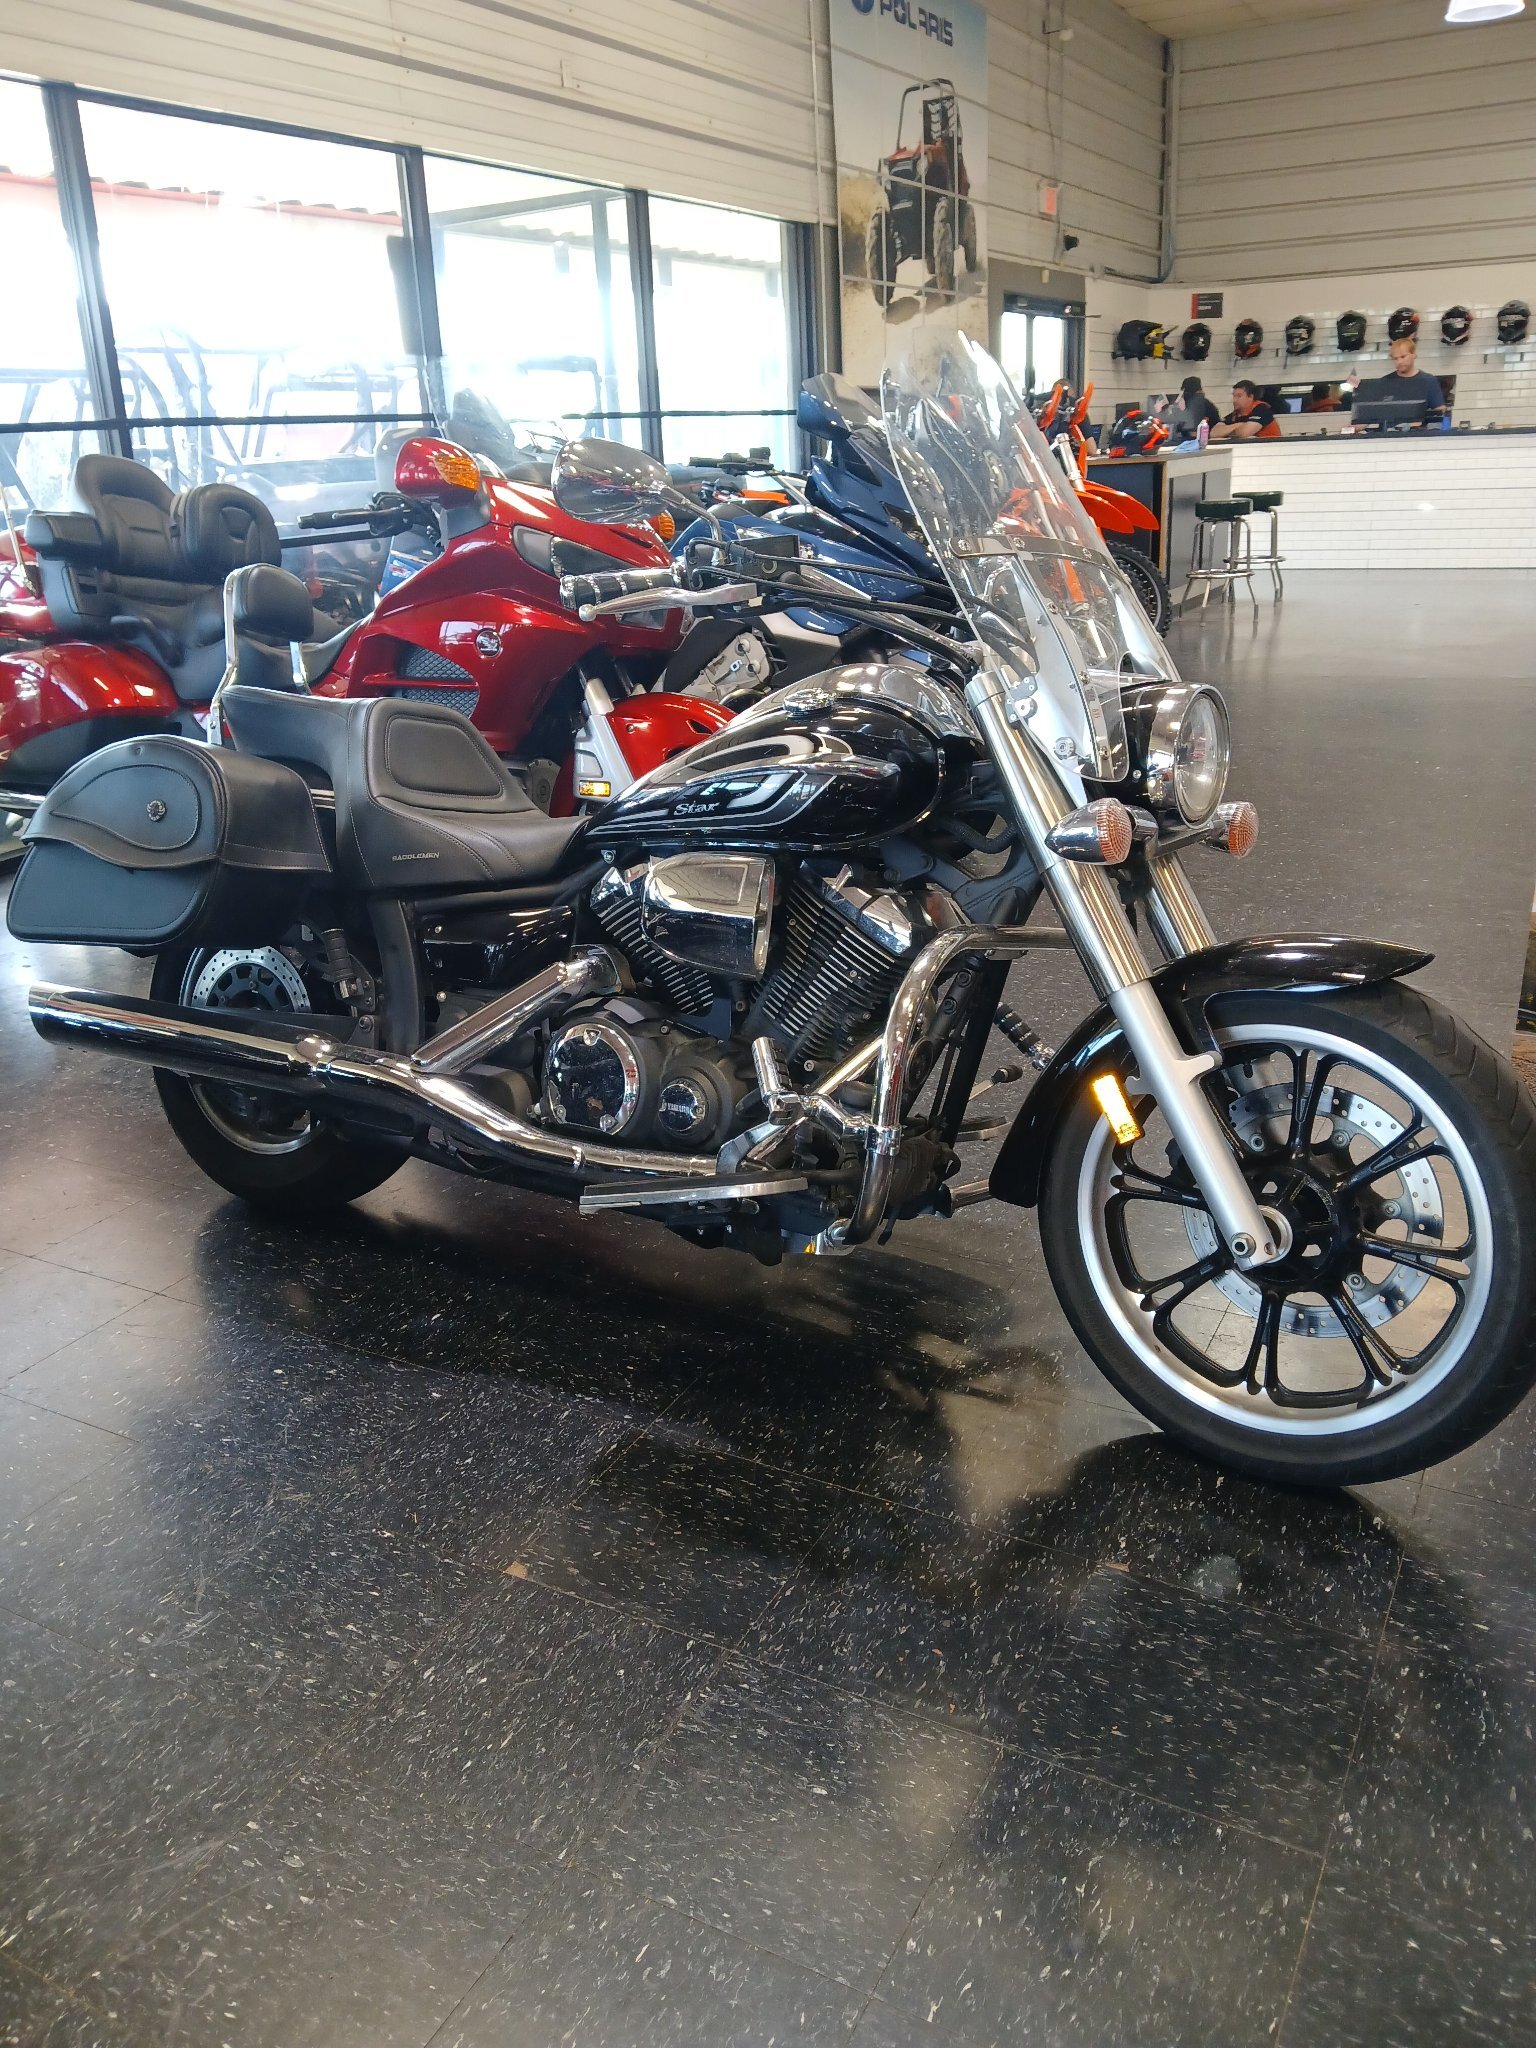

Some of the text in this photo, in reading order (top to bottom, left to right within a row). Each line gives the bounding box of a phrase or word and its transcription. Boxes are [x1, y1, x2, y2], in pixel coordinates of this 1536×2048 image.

[880, 0, 953, 47] POLARIS
[673, 800, 720, 816] Star
[391, 852, 440, 861] SADDLEMEN
